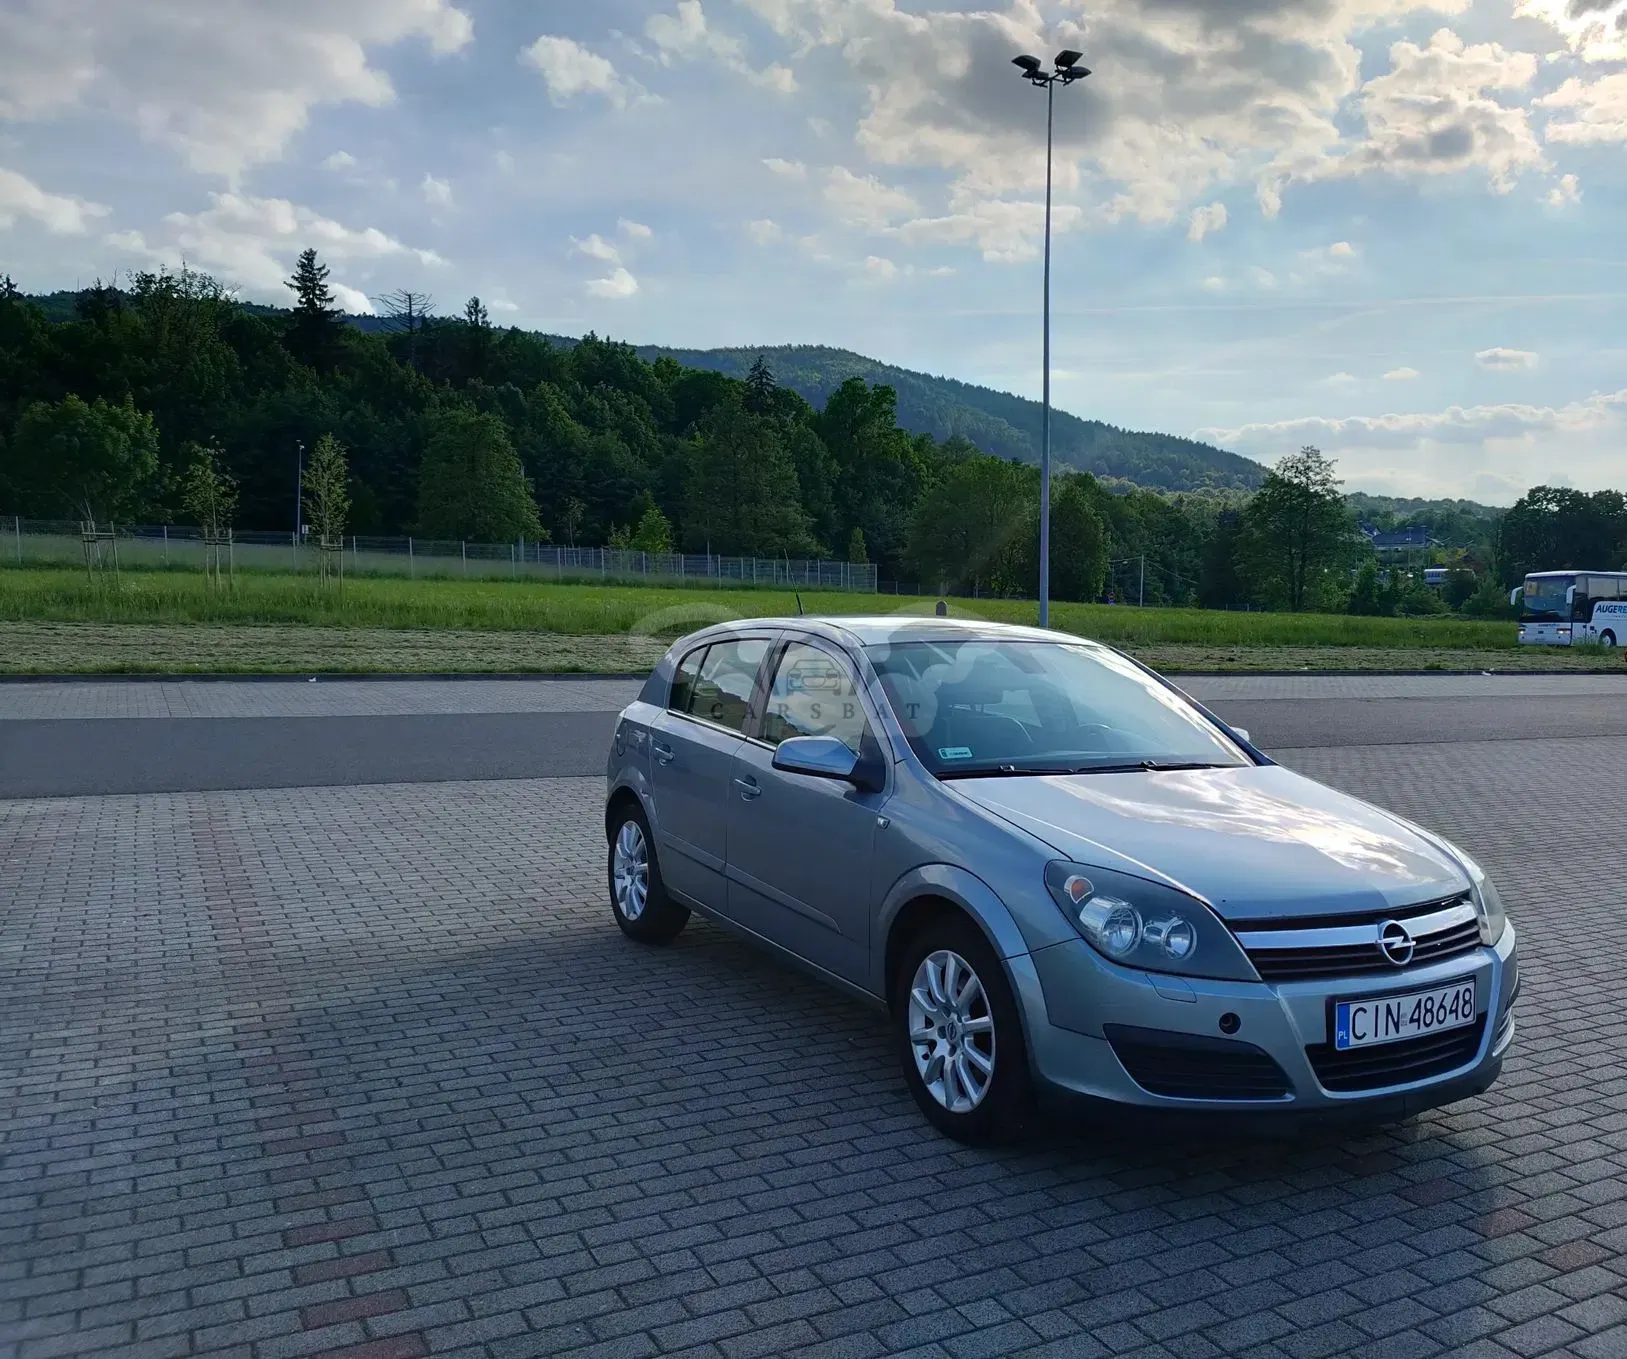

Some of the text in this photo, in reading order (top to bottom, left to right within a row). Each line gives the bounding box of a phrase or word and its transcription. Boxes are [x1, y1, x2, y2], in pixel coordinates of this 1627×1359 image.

[1351, 987, 1473, 1041] CIN 48648
[1338, 1030, 1348, 1040] PL
